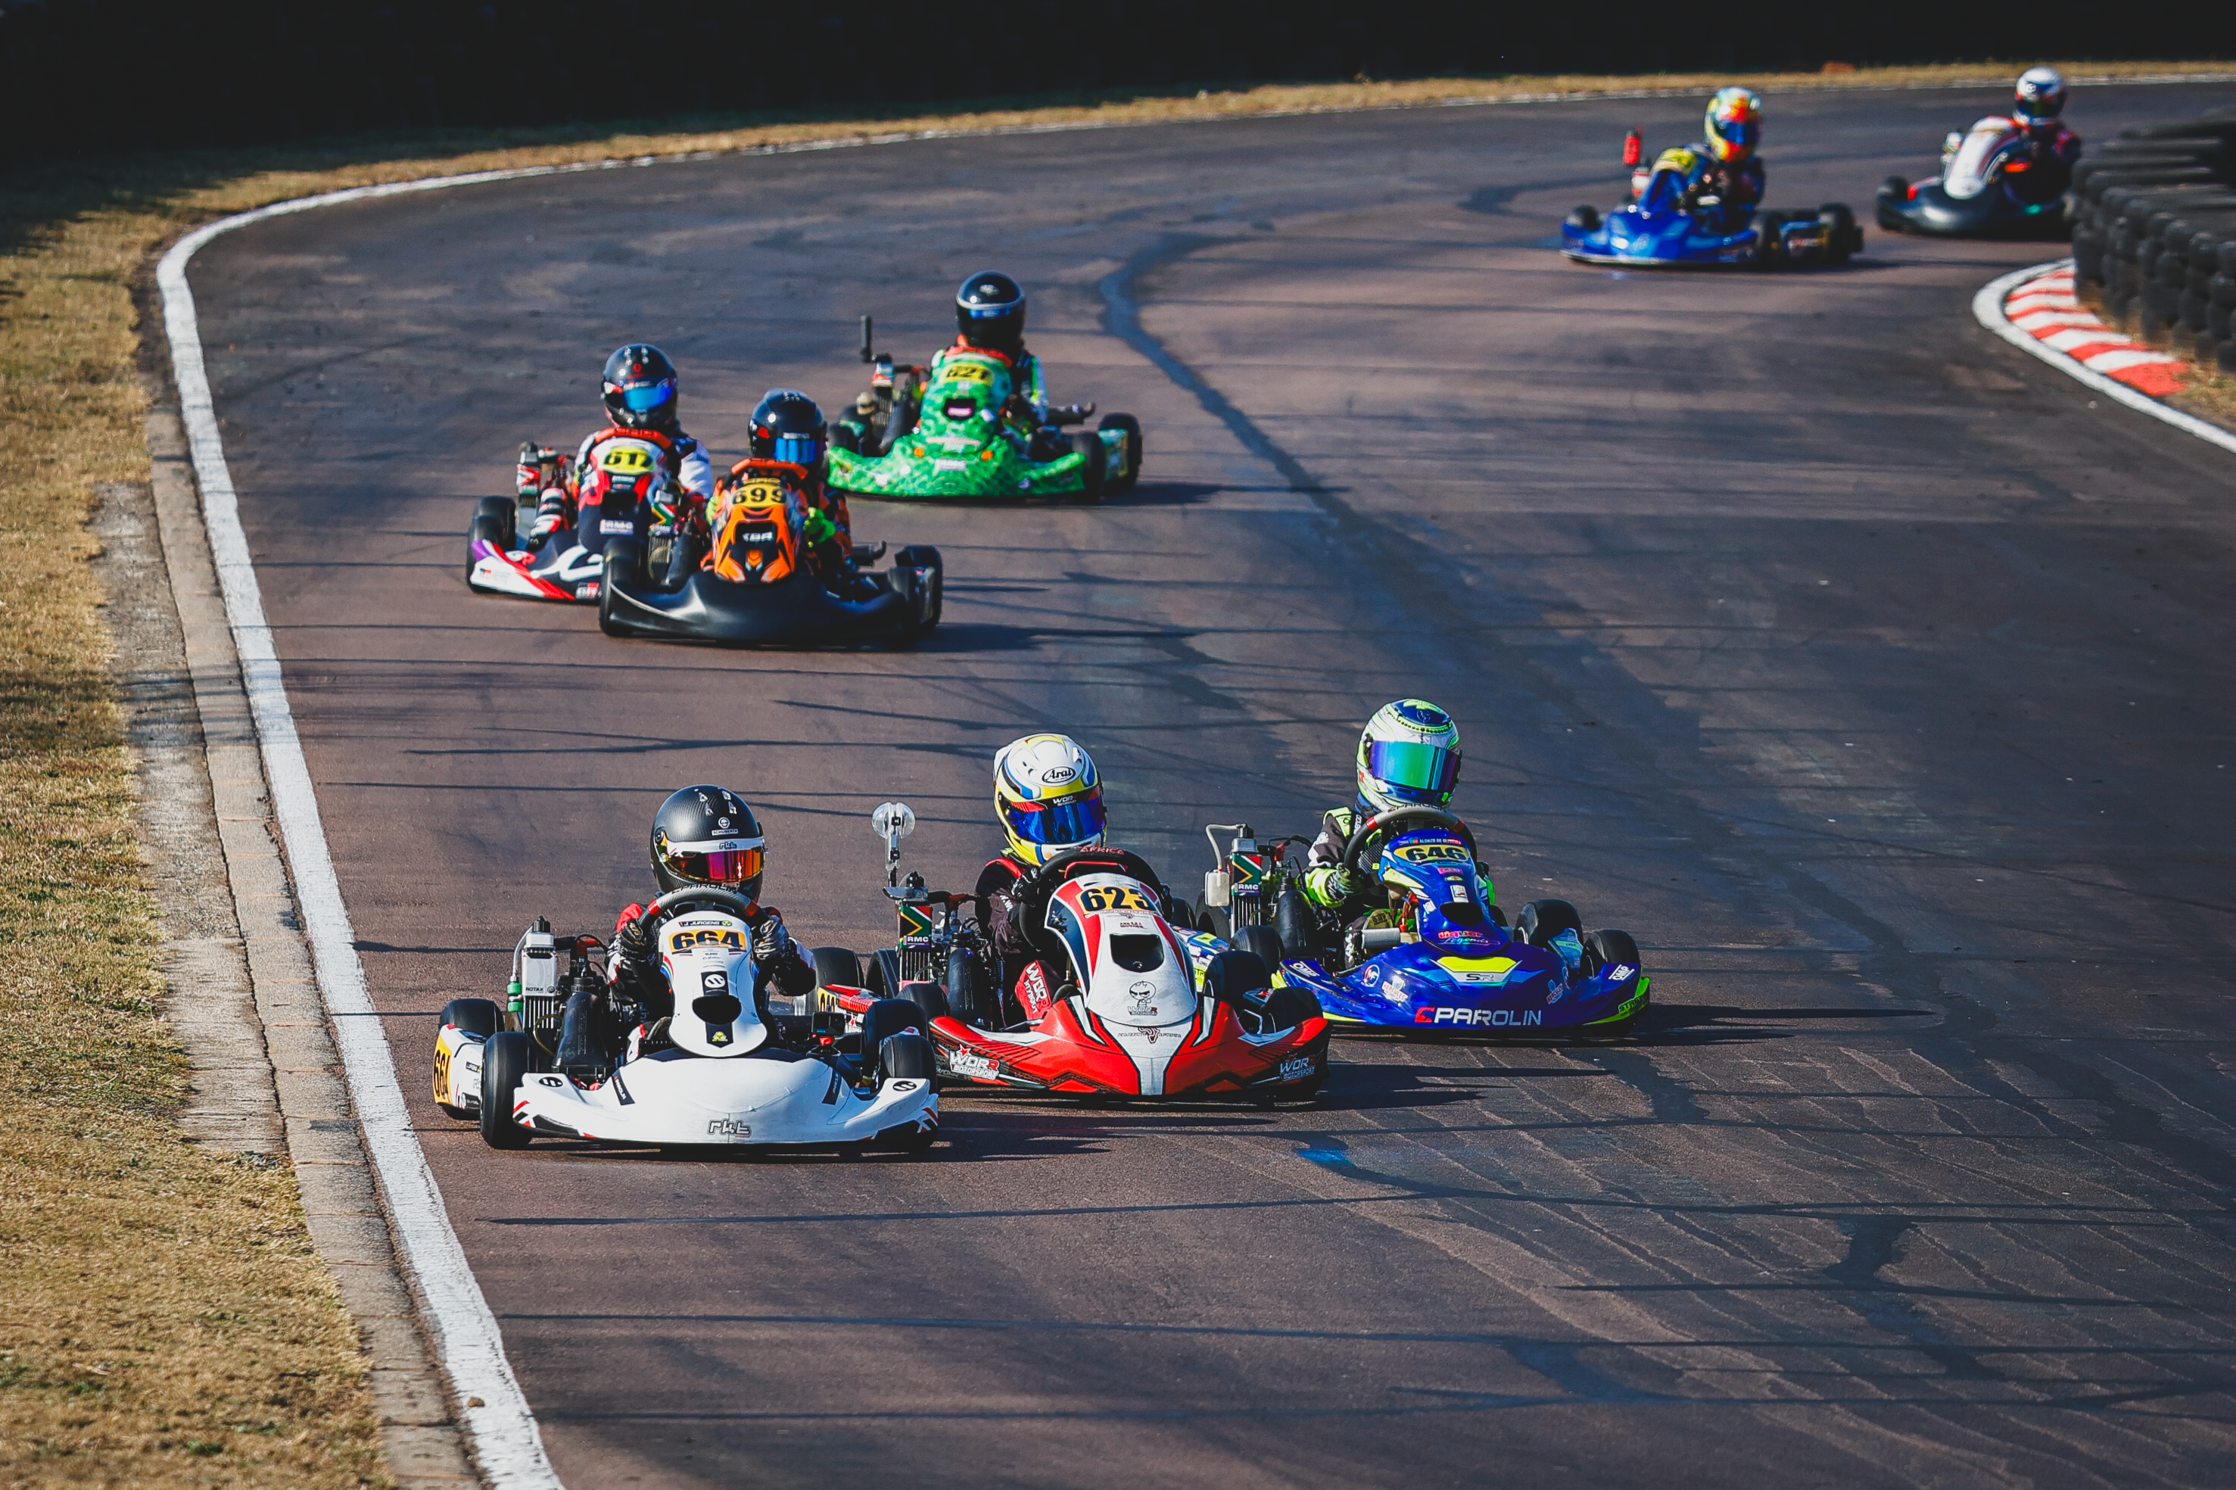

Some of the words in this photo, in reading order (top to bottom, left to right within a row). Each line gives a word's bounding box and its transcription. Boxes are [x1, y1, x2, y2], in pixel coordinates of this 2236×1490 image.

[1048, 768, 1072, 779] Arai
[1405, 846, 1468, 862] 646
[1080, 886, 1157, 912] 623
[672, 930, 743, 951] 664
[1612, 965, 1630, 980] OMP
